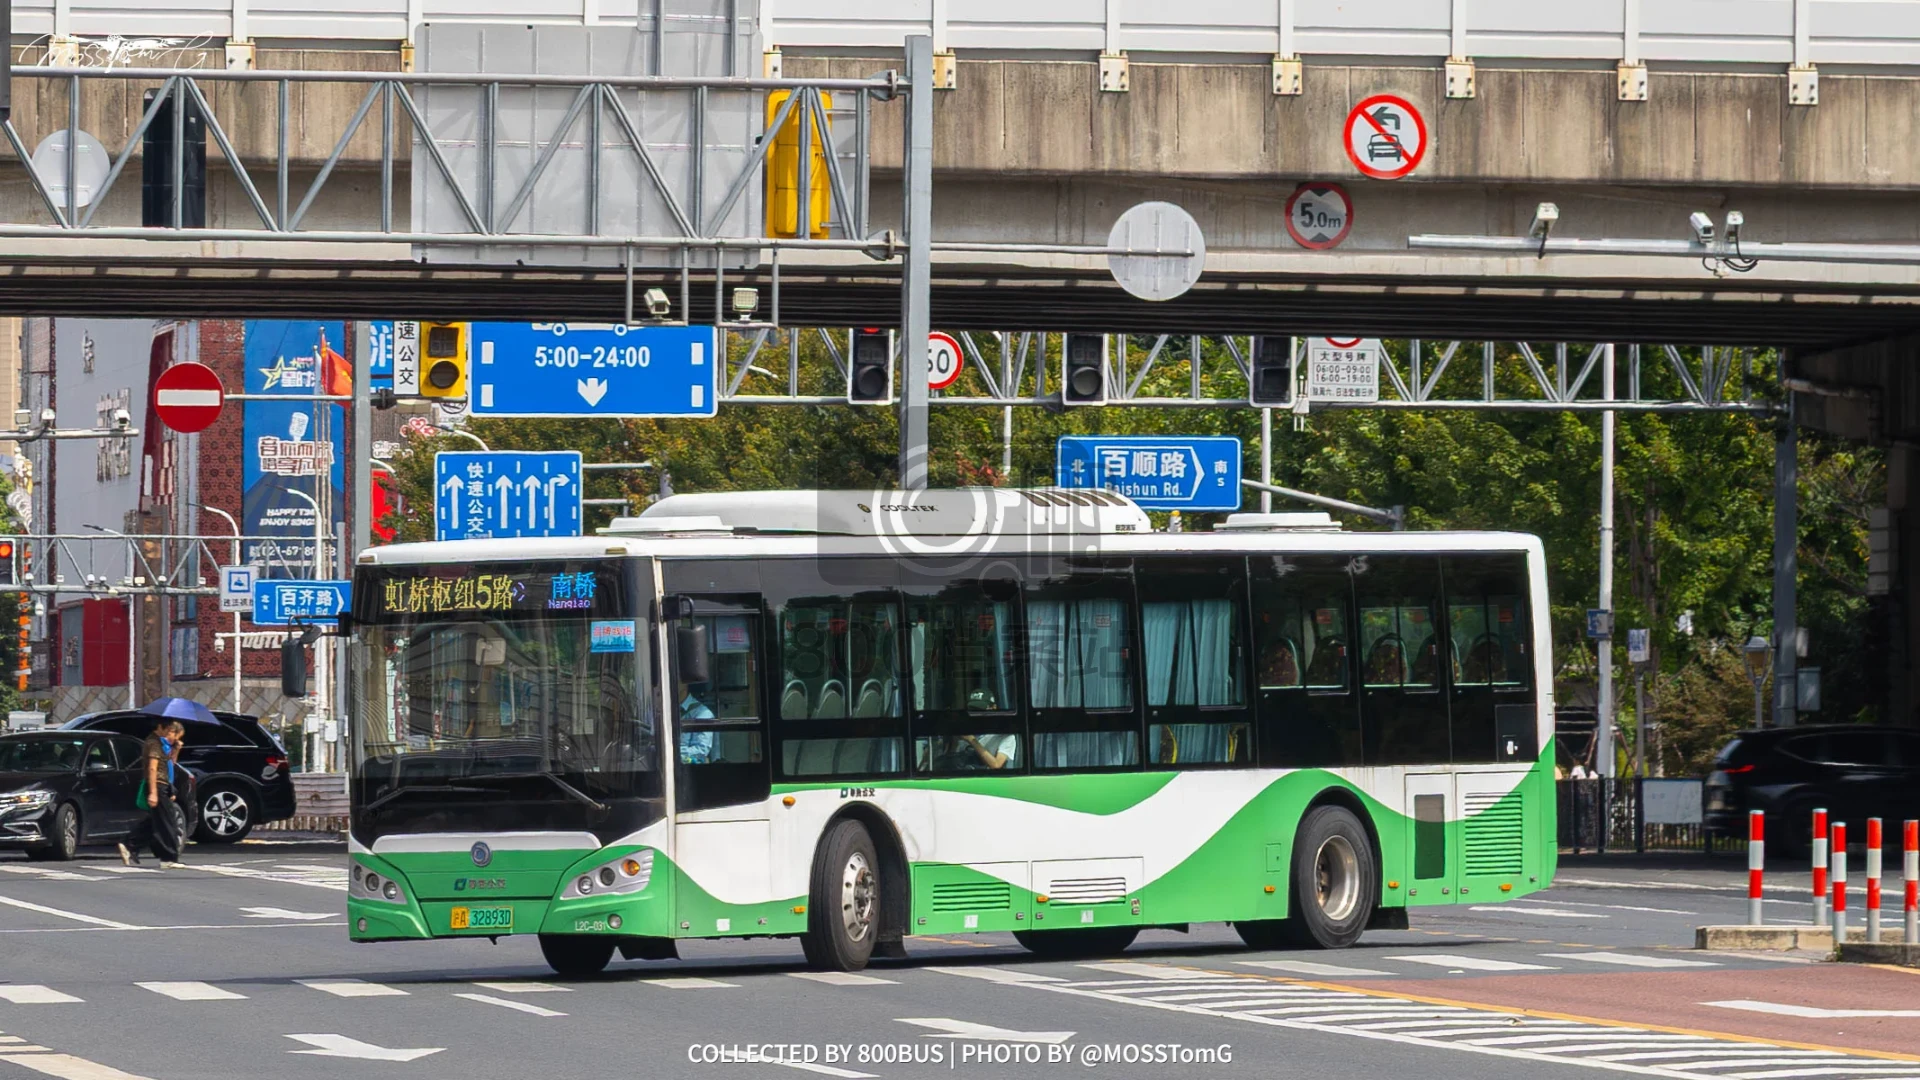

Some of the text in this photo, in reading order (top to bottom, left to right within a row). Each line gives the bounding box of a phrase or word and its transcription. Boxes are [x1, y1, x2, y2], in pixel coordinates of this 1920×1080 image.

[1300, 202, 1342, 229] 5.0m
[534, 346, 651, 368] 5:00-24:00
[1320, 351, 1366, 361] 大型号牌
[1315, 365, 1371, 374] 06:00-09:00
[1315, 374, 1371, 383] 16:00-19:00
[1071, 459, 1085, 473] 北
[1101, 450, 1187, 478] 百顺路
[1214, 460, 1228, 474] 南
[1074, 477, 1083, 486] N
[1217, 478, 1226, 487] S
[1163, 482, 1183, 496] Rd.
[466, 462, 485, 532] 快速公交
[551, 572, 597, 600] 南桥
[280, 588, 333, 606] 百齐路
[547, 599, 591, 610] Nanqiao
[471, 909, 512, 926] 32893D
